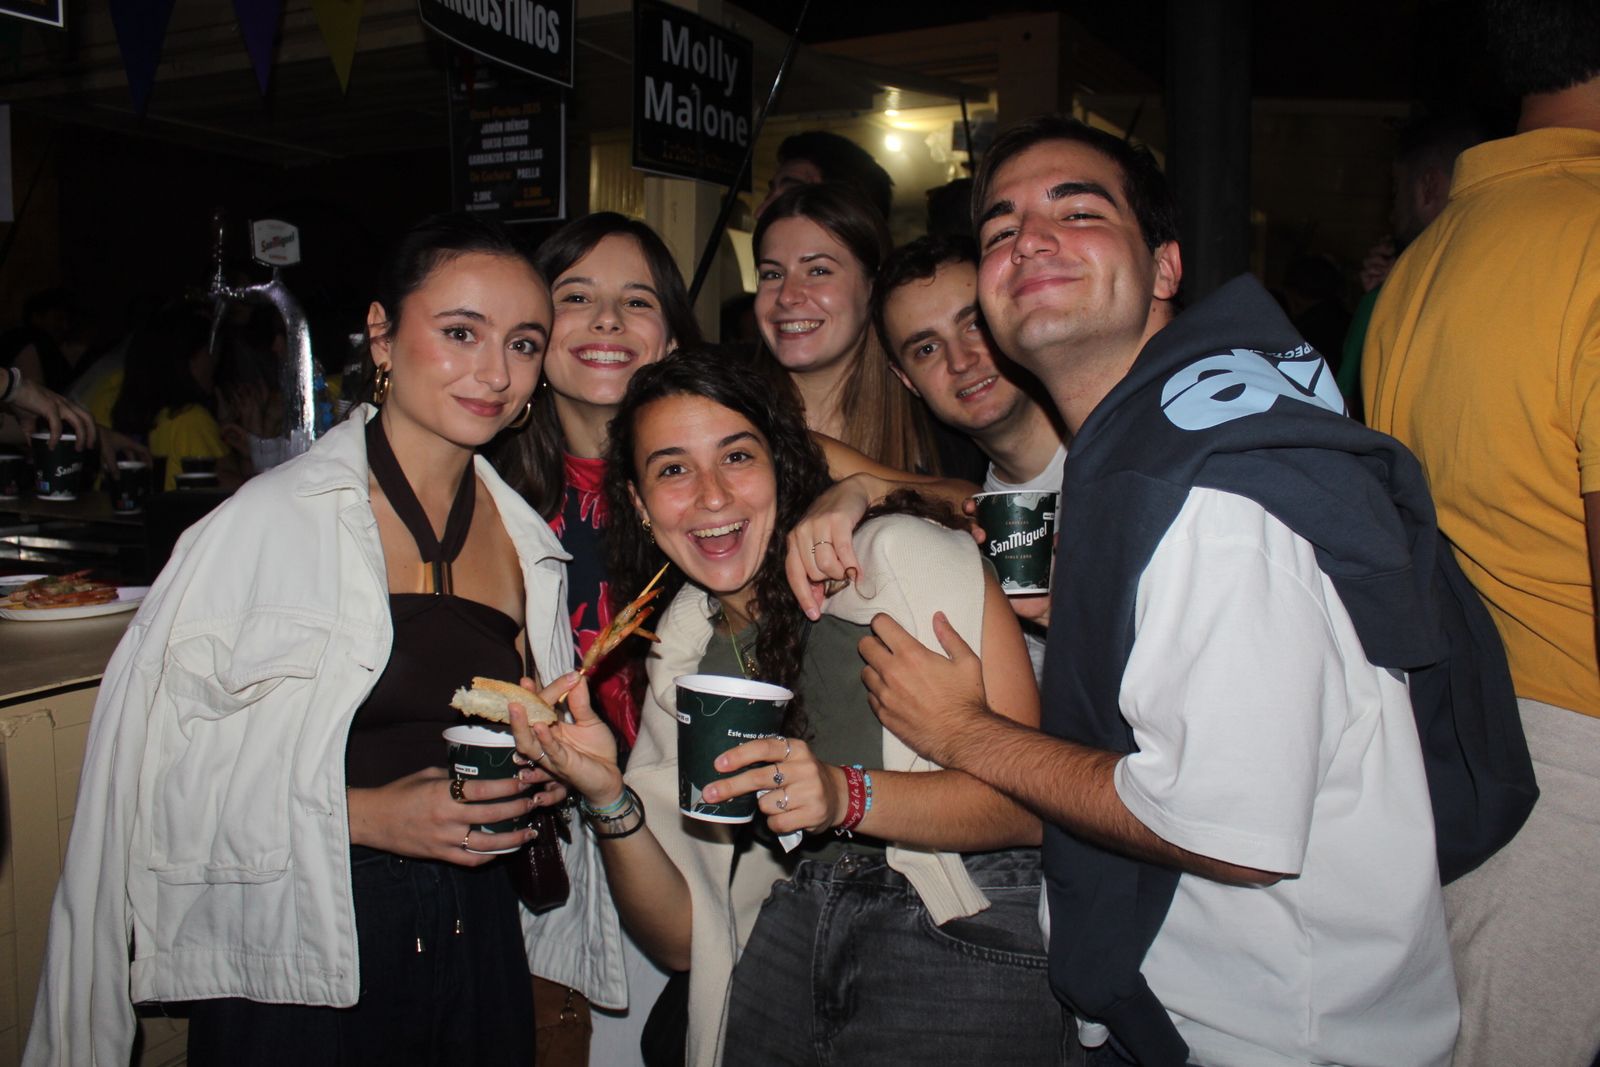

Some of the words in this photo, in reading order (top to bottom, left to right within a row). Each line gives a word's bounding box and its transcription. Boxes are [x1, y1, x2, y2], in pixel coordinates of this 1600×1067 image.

[661, 18, 739, 97] Molly
[643, 75, 749, 148] Malone
[990, 521, 1048, 557] SanMiguel
[728, 729, 742, 737] Este
